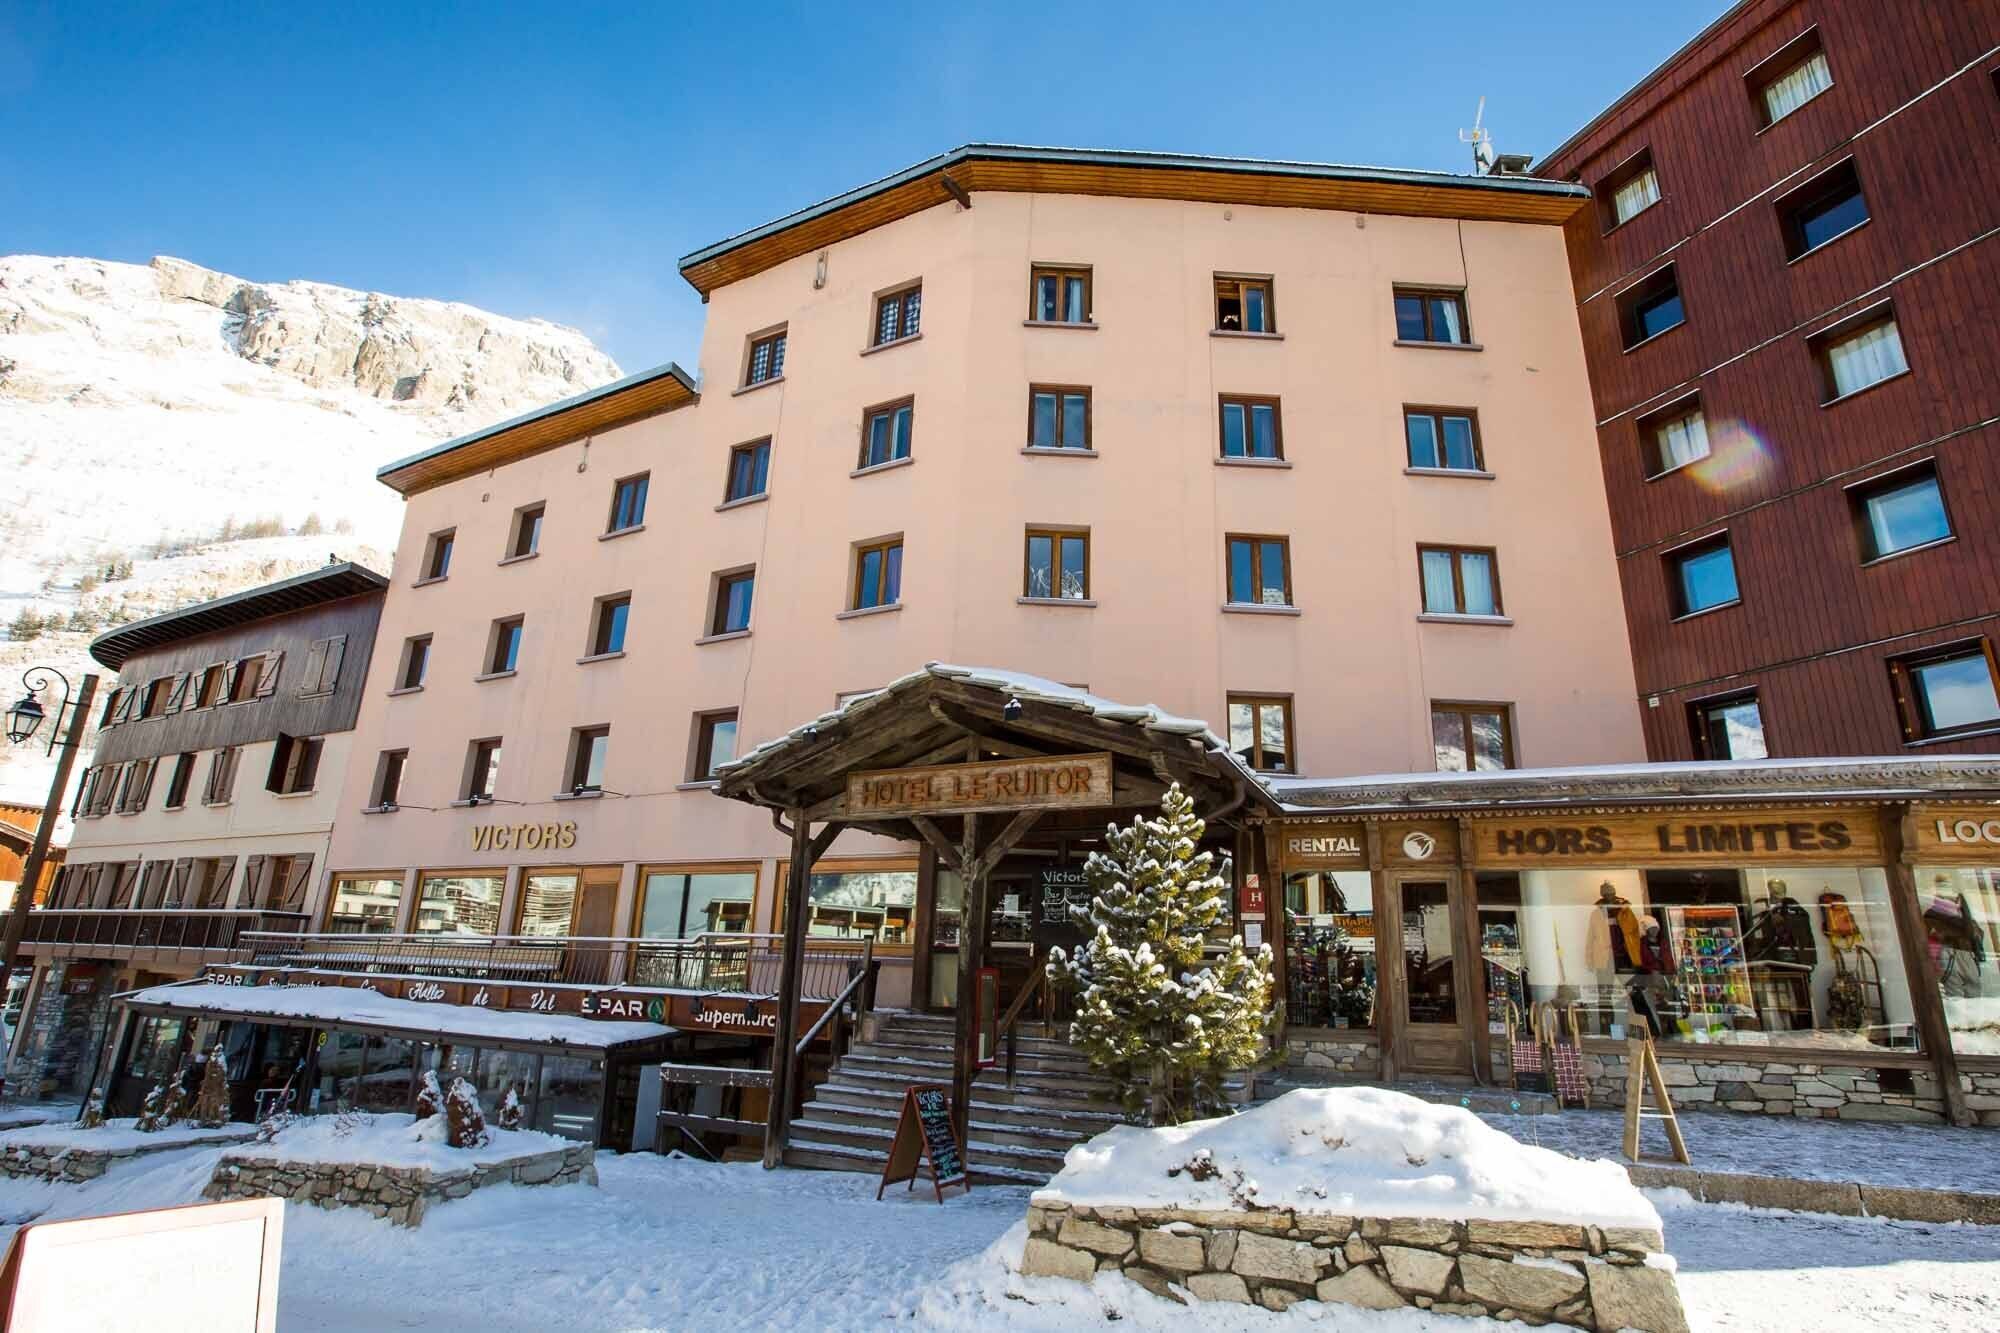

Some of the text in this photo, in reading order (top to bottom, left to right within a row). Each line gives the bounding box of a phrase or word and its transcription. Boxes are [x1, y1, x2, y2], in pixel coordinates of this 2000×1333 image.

[863, 765, 1093, 808] HOTEL LE RUITOR
[472, 821, 578, 851] VICTORS
[1496, 820, 1853, 855] HORS LIMITES
[1935, 819, 2000, 844] LOC
[1288, 836, 1361, 853] RENTAL
[1251, 891, 1262, 902] H
[207, 973, 243, 987] SPAR
[472, 986, 489, 1006] de
[530, 988, 557, 1011] Val
